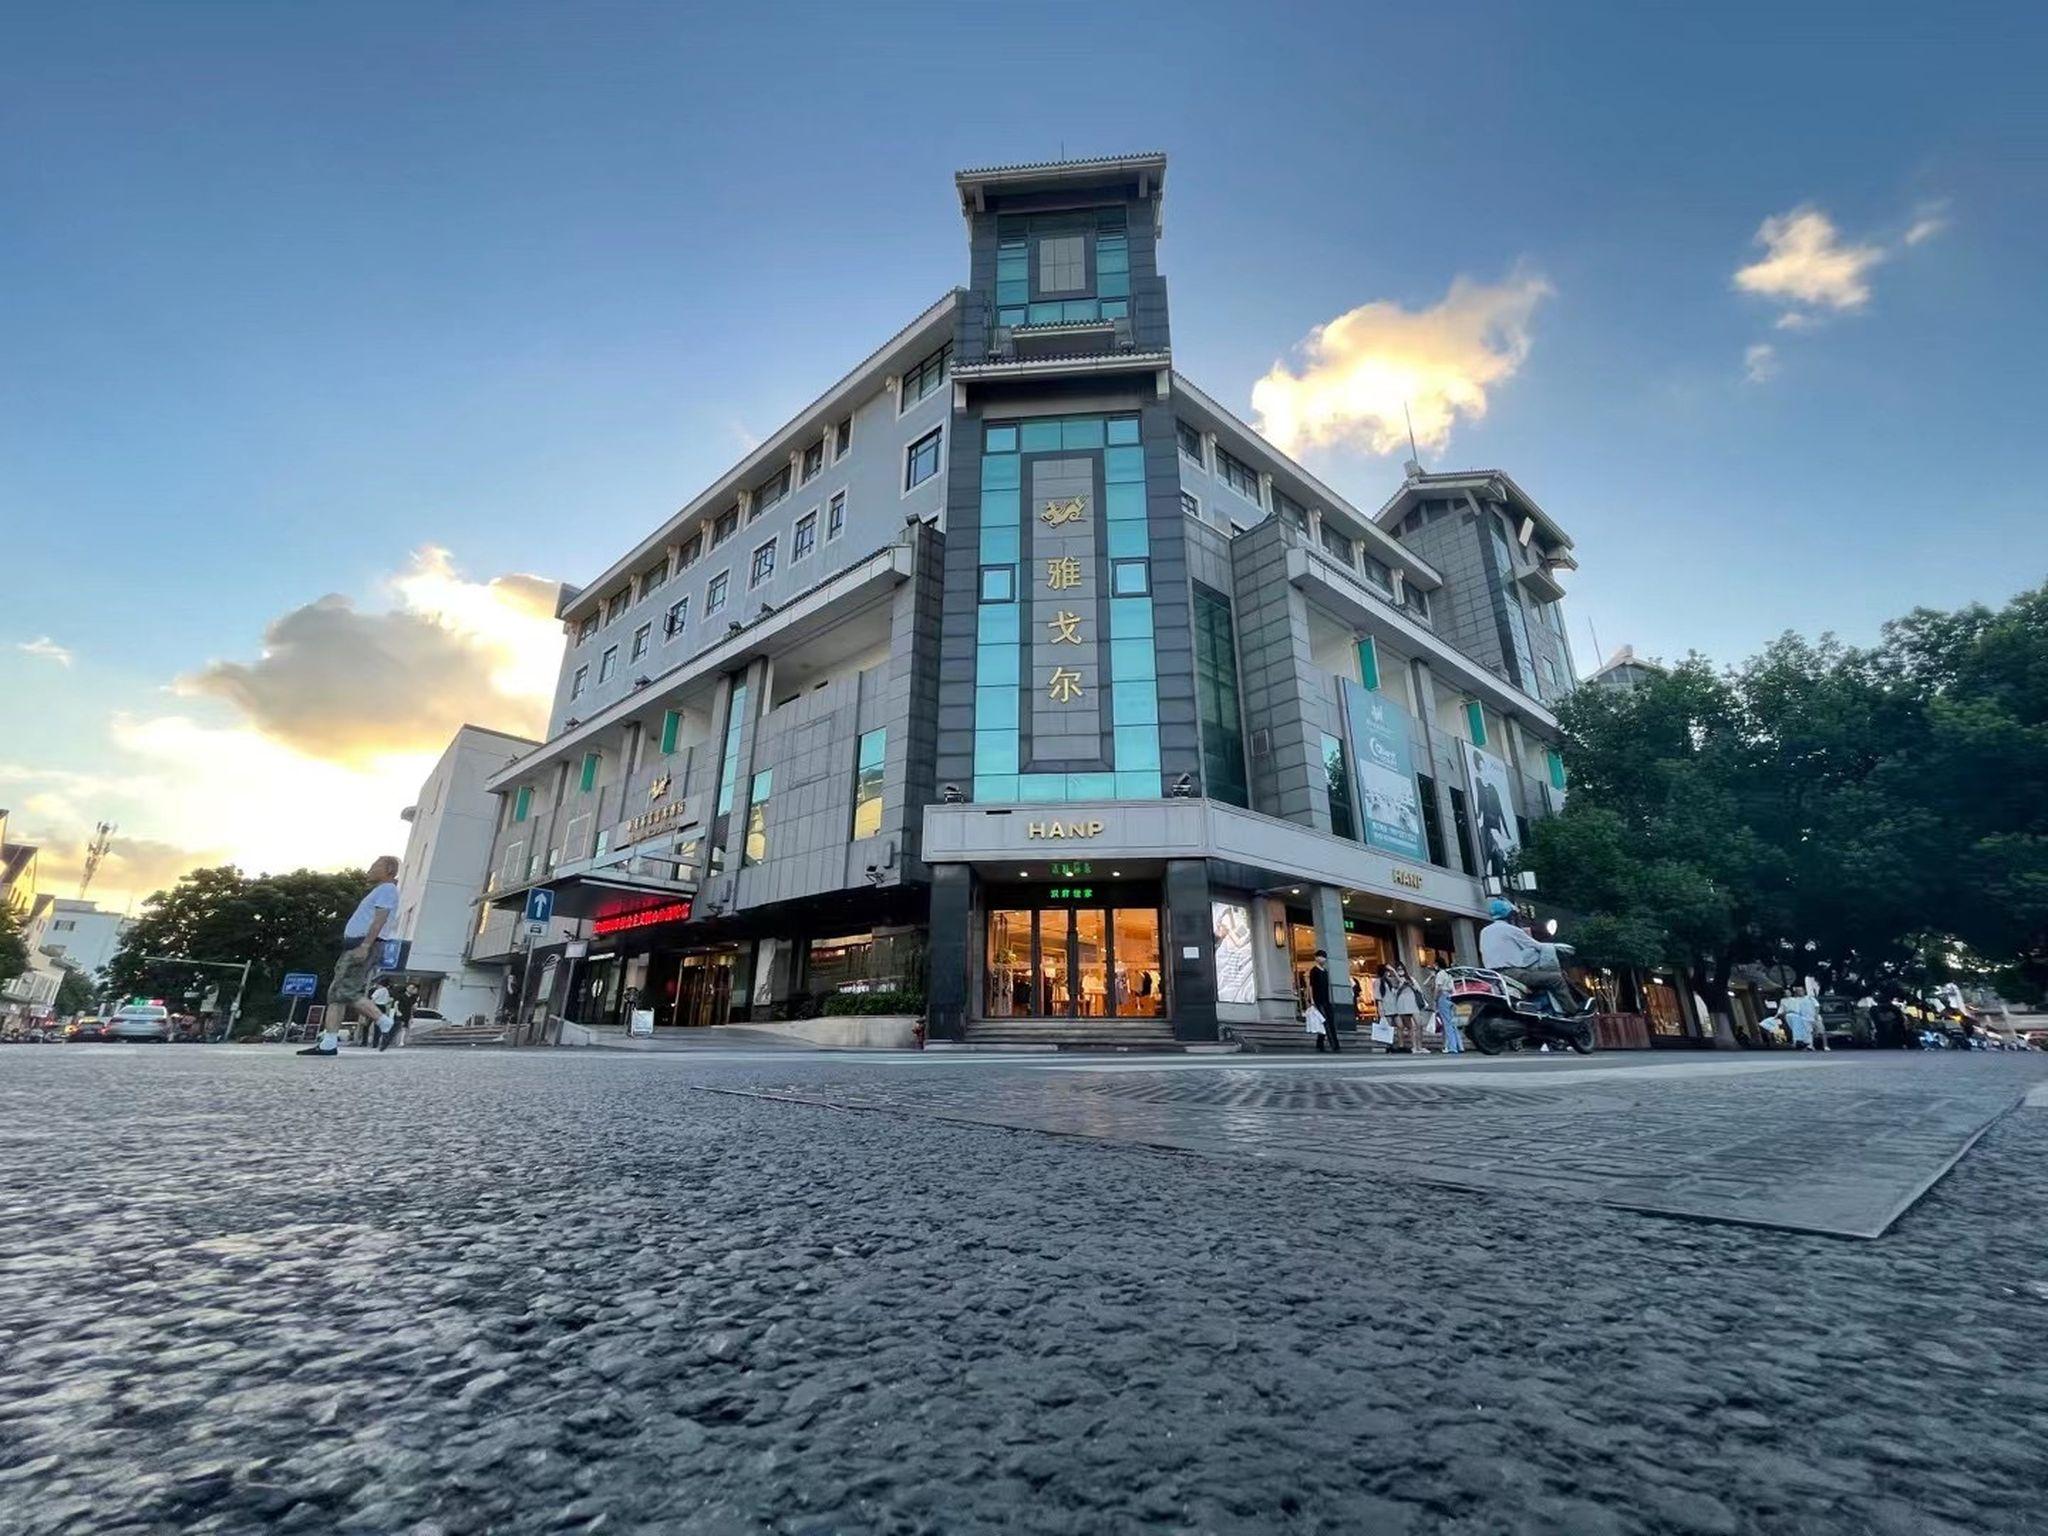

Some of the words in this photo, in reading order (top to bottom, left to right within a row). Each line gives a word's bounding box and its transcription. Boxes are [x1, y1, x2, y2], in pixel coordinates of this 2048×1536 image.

[1047, 556, 1083, 703] 雅戈尔
[1029, 821, 1104, 839] HANP
